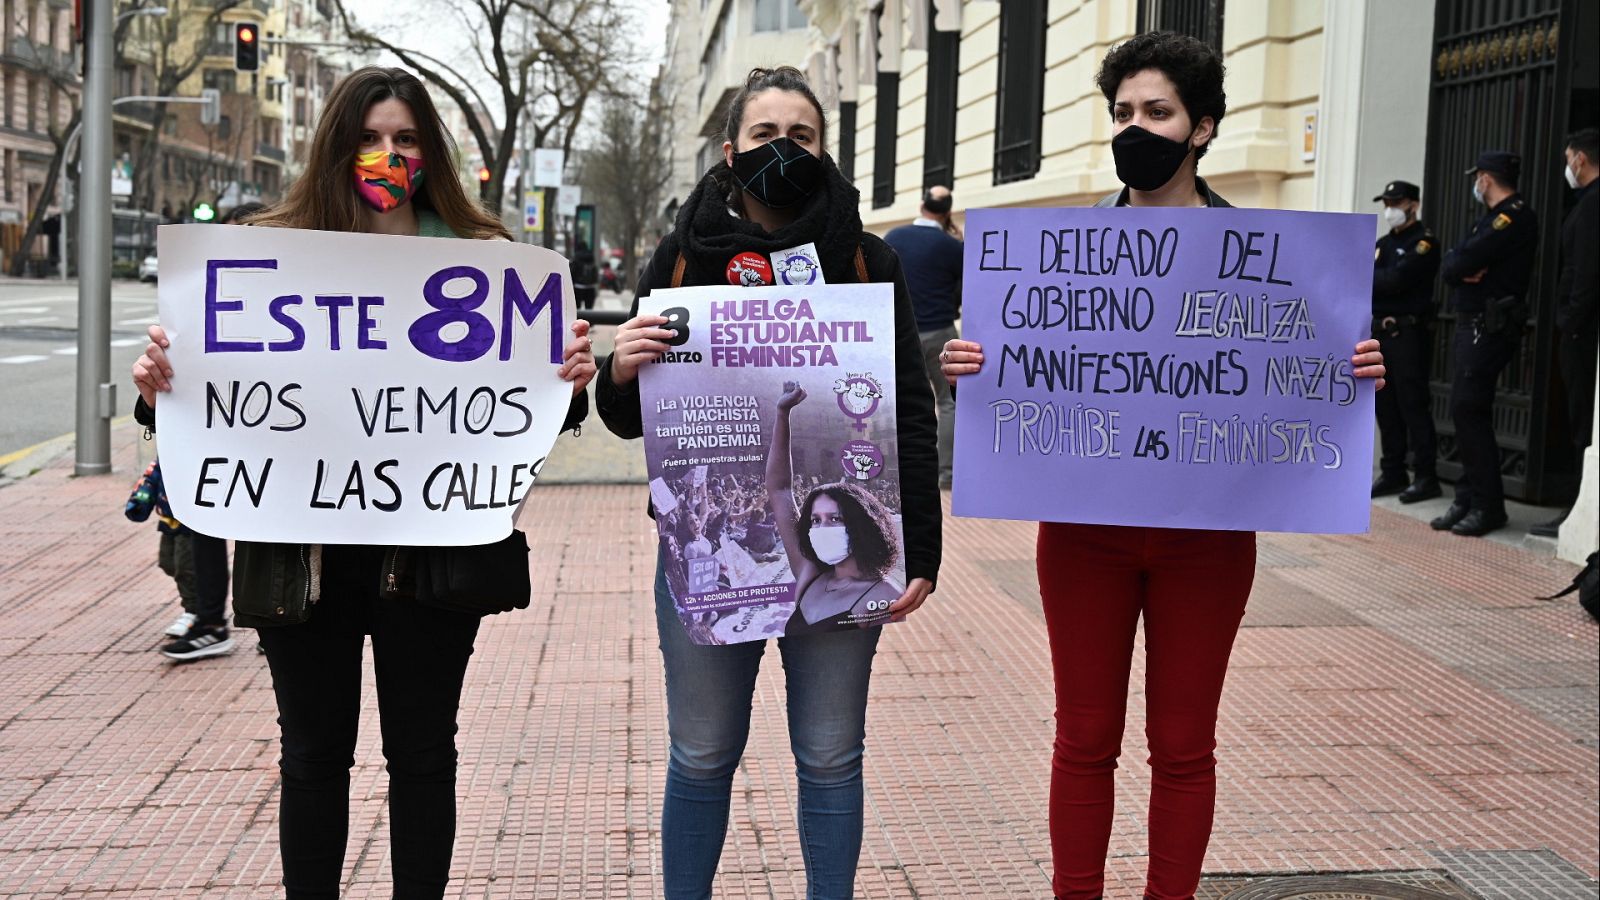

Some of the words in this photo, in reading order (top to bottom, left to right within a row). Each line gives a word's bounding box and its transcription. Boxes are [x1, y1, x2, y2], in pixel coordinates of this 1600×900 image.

[979, 230, 1022, 272] EL
[1039, 227, 1179, 277] DELEGADO
[1218, 229, 1292, 286] DEL
[407, 265, 564, 364] 8M
[710, 299, 815, 321] HUELGA
[658, 306, 690, 347] 8
[710, 321, 874, 344] ESTUDIANTIL
[710, 345, 839, 367] FEMINISTA
[206, 381, 306, 431] NOS
[351, 385, 533, 437] VEMOS
[656, 398, 677, 413] ¡La
[680, 395, 758, 408] VIOLENCIA
[682, 408, 760, 422] MACHISTA
[656, 422, 712, 437] también
[716, 424, 732, 434] es
[735, 423, 760, 433] una
[677, 434, 761, 449] PANDEMIA!
[1133, 426, 1169, 460] LAS
[661, 458, 687, 468] ¡Fuera
[688, 457, 699, 465] de
[701, 455, 736, 464] nuestras
[738, 453, 763, 462] aulas!
[195, 457, 273, 508] EN
[310, 458, 402, 512] LAS
[703, 591, 737, 602] ACCIONES
[738, 589, 749, 598] DE
[750, 586, 789, 596] PROTESTA
